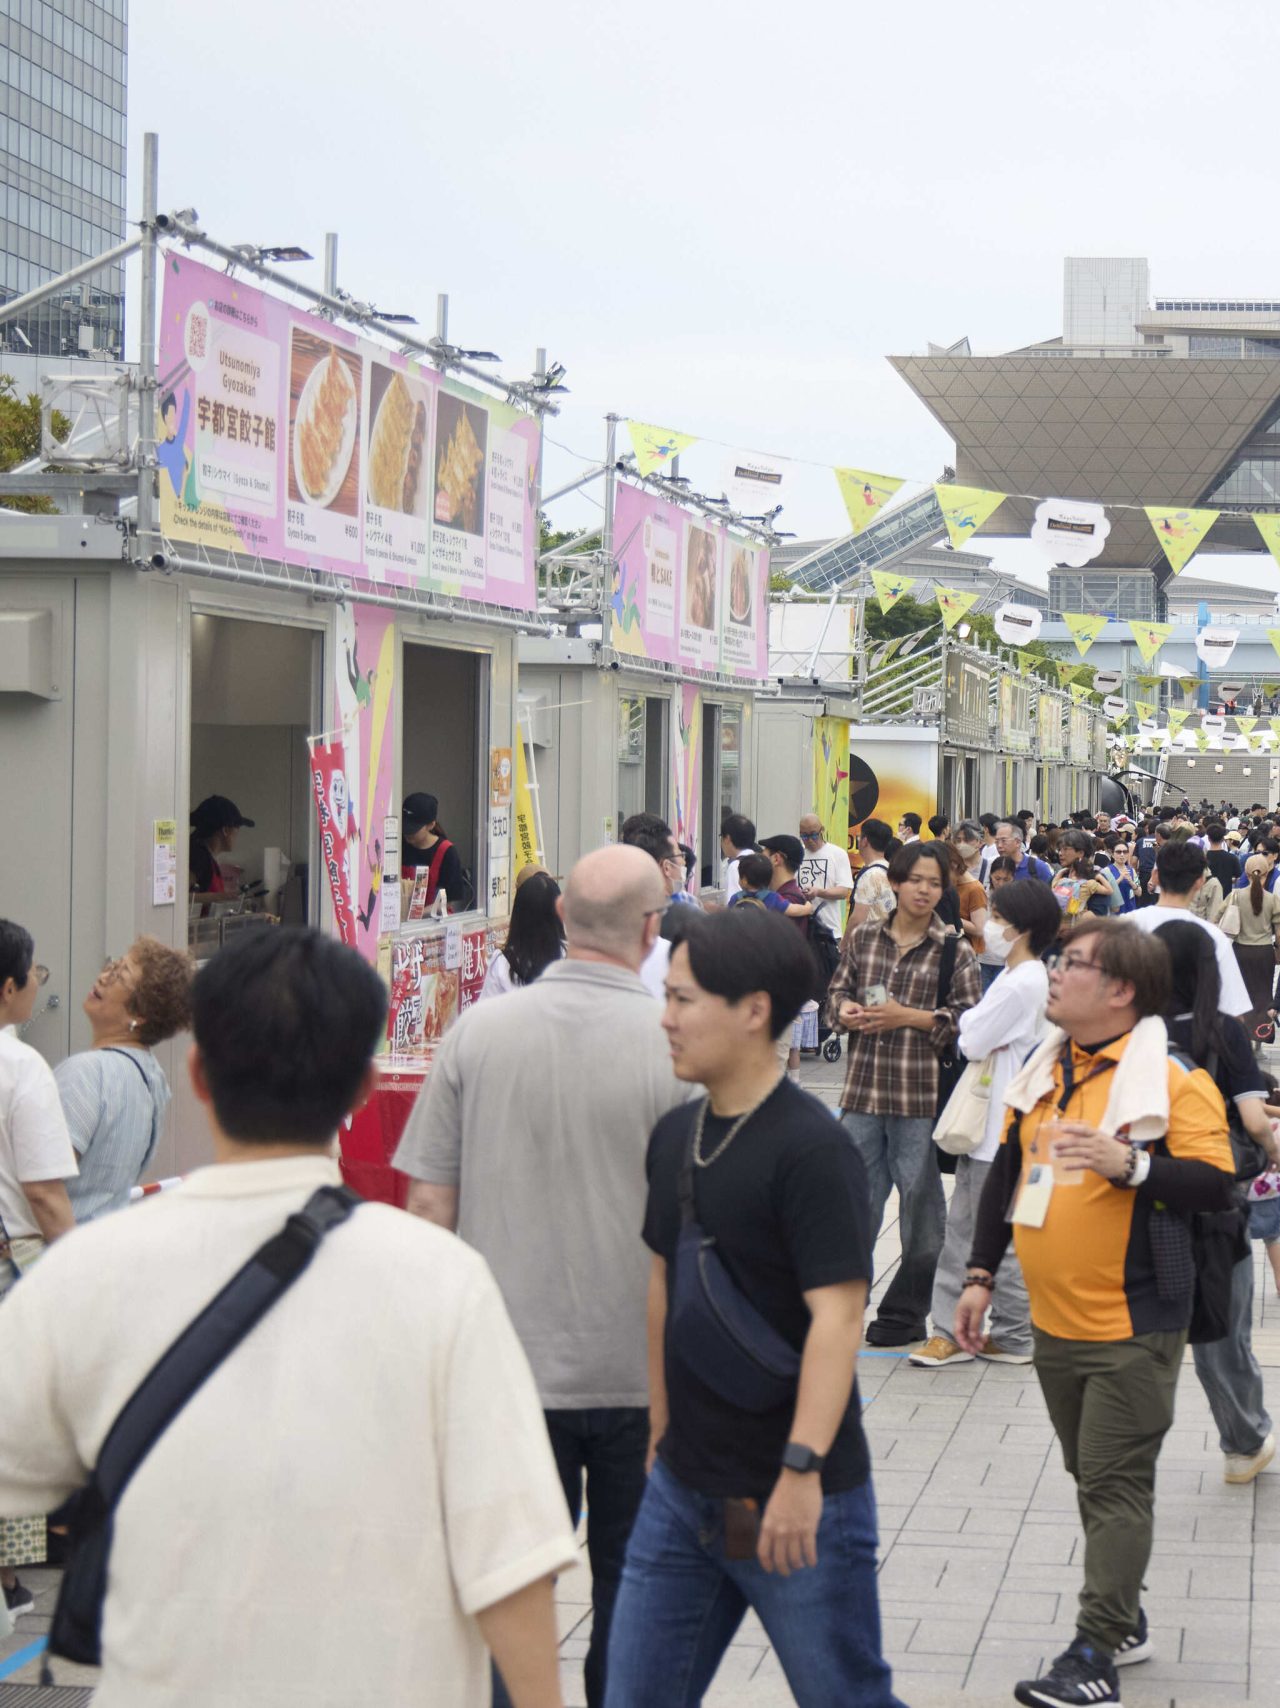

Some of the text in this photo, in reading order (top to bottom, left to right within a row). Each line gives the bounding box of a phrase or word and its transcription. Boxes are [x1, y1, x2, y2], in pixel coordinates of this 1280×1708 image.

[220, 350, 260, 379] Utsunomiya
[222, 374, 256, 398] Gyozakan
[198, 396, 276, 452] 宇都宮餃子館
[1213, 505, 1268, 517] OKYO
[345, 524, 358, 538] ¥600
[492, 816, 508, 837] 注文口
[394, 940, 424, 991] ピザ
[462, 935, 485, 982] 健太
